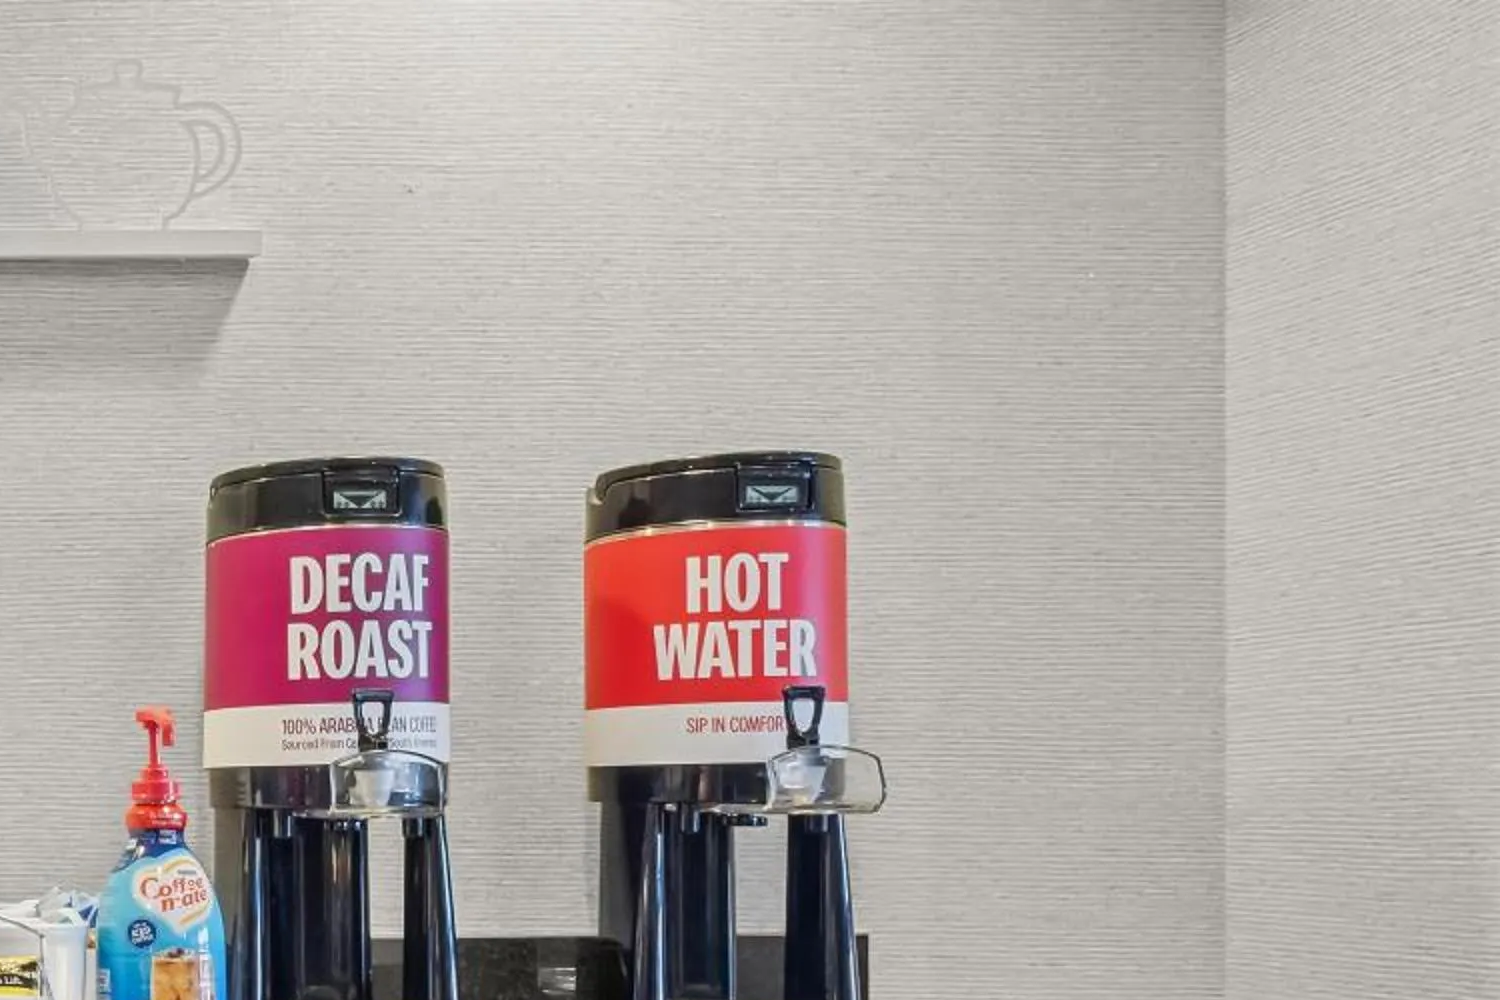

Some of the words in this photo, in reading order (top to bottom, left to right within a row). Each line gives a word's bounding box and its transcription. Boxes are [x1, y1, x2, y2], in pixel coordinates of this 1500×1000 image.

[289, 552, 429, 615] DECAF
[685, 552, 790, 614] HOT
[287, 619, 433, 681] ROAST
[653, 619, 817, 681] WATER
[282, 717, 317, 735] 100%
[686, 717, 708, 733] SIP
[711, 717, 725, 732] IN
[729, 715, 785, 733] COMFOR
[140, 877, 205, 899] Coffee
[160, 888, 208, 912] mate
